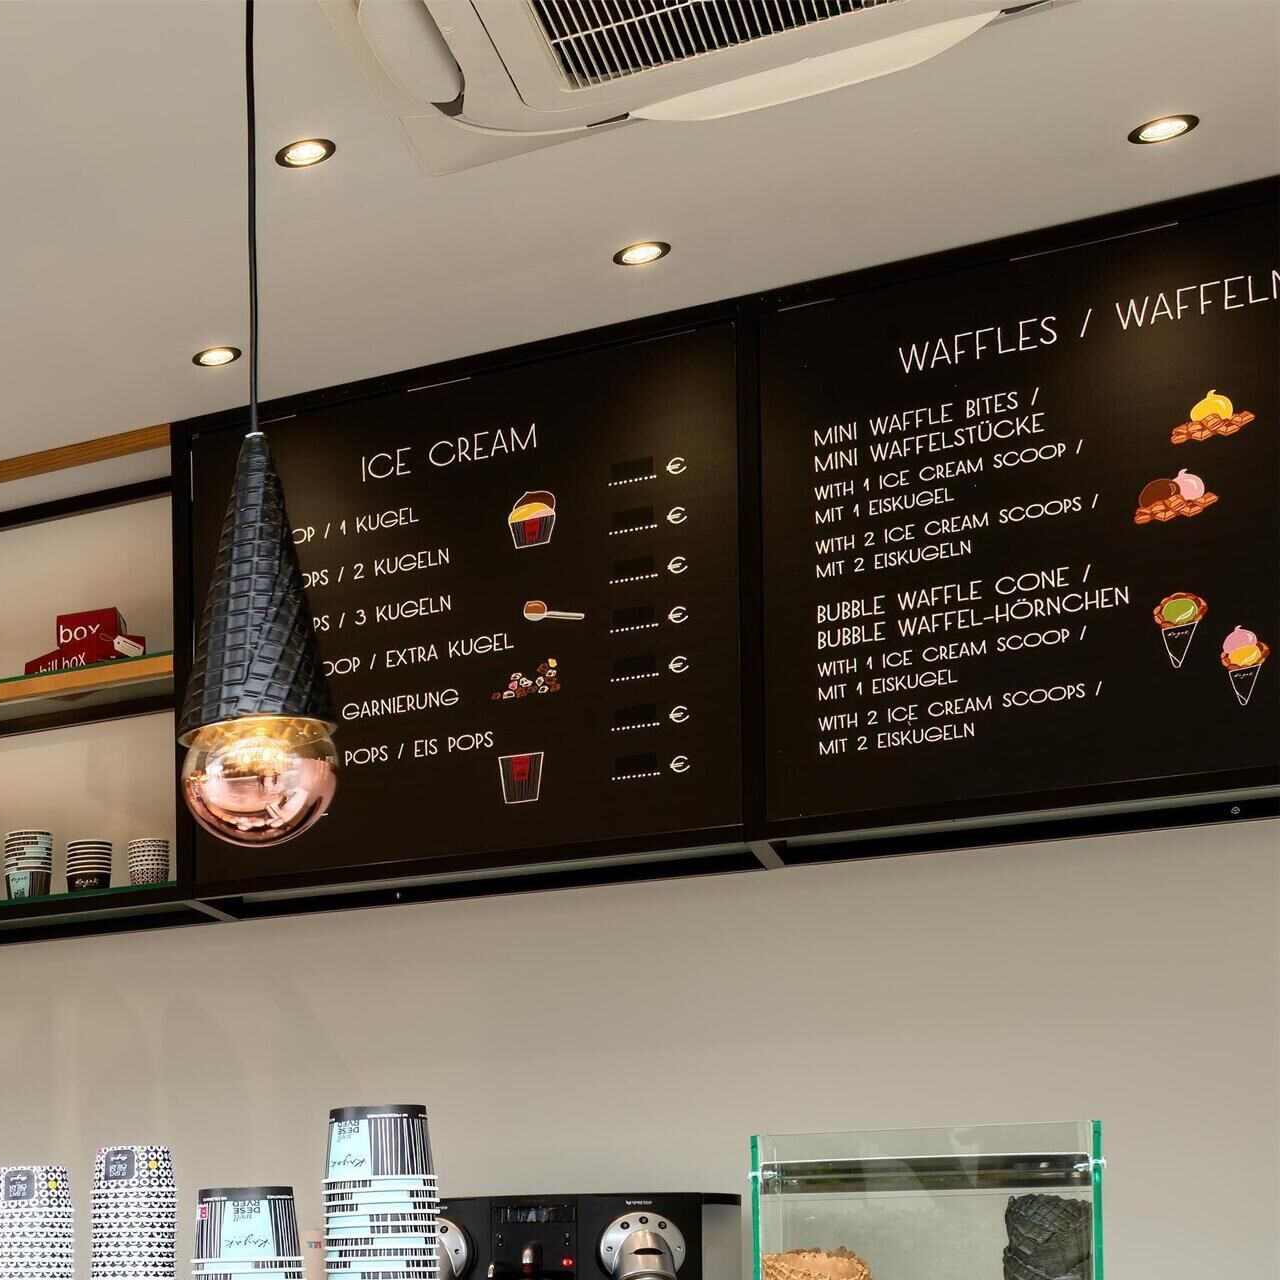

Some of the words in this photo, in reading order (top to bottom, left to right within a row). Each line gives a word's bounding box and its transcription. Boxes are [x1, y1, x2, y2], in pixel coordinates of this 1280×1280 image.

[898, 315, 1058, 374] WAFFLES
[1079, 308, 1093, 338] /
[814, 421, 858, 447] MINI
[869, 402, 953, 436] WAFFLE
[966, 391, 1019, 419] BITES
[1030, 386, 1040, 406] /
[361, 446, 412, 482] ICE
[428, 423, 537, 467] CREAM
[814, 447, 858, 473] MINI
[869, 411, 1046, 464] WAFFELSTÜCKE
[665, 456, 687, 475] €
[814, 480, 854, 501] WITH
[863, 477, 870, 492] 1
[879, 469, 910, 490] ICE
[918, 457, 984, 482] CREAM
[993, 442, 1067, 469] SCOOP
[1075, 438, 1084, 455] /
[323, 522, 331, 539] /
[339, 519, 346, 536] 1
[355, 507, 420, 534] KUGEL
[666, 506, 688, 525] €
[815, 505, 844, 525] MIT
[853, 503, 860, 518] 1
[868, 487, 955, 516] EISKUGEL
[815, 534, 855, 555] WITH
[864, 531, 876, 547] 2
[884, 523, 915, 544] ICE
[924, 511, 989, 536] CREAM
[998, 496, 1082, 524] SCOOPS
[1091, 493, 1099, 509] /
[337, 566, 345, 583] /
[353, 562, 365, 580] 2
[374, 547, 450, 577] KUGELN
[666, 556, 689, 574] €
[815, 559, 845, 579] MIT
[853, 557, 865, 573] 2
[874, 539, 972, 570] EISKUGELN
[338, 612, 346, 629] /
[354, 609, 367, 626] 3
[375, 594, 452, 623] KUGELN
[817, 594, 886, 624] BUBBLE
[897, 579, 983, 611] WAFFLE
[994, 566, 1070, 595] CONE
[1082, 563, 1091, 583] /
[667, 605, 689, 624] €
[817, 621, 886, 650] BUBBLE
[897, 584, 1131, 640] WAFFEL-HÖRNCHEN
[59, 623, 101, 645] box
[817, 657, 857, 678] WITH
[866, 655, 873, 670] 1
[882, 649, 913, 669] ICE
[921, 639, 987, 662] CREAM
[996, 628, 1070, 652] SCOOP
[1079, 625, 1087, 641] /
[322, 656, 361, 677] OOP
[369, 653, 377, 670] /
[386, 643, 439, 668] EXTRA
[448, 632, 515, 659] KUGEL
[668, 655, 690, 674] €
[817, 683, 847, 701] MIT
[856, 681, 863, 696] 1
[872, 668, 958, 695] EISKUGEL
[341, 688, 460, 721] GARNIERUNG
[668, 705, 690, 723] €
[818, 712, 858, 732] WITH
[867, 710, 879, 726] 2
[887, 704, 919, 726] ICE
[927, 695, 993, 717] CREAM
[1002, 683, 1086, 708] SCOOPS
[1095, 680, 1103, 696] /
[344, 745, 389, 767] POPS
[397, 743, 405, 760] /
[414, 738, 438, 758] EIS
[447, 731, 494, 753] POPS
[818, 737, 848, 756] MIT
[857, 735, 868, 751] 2
[877, 721, 975, 749] EISKUGELN
[669, 755, 691, 773] €
